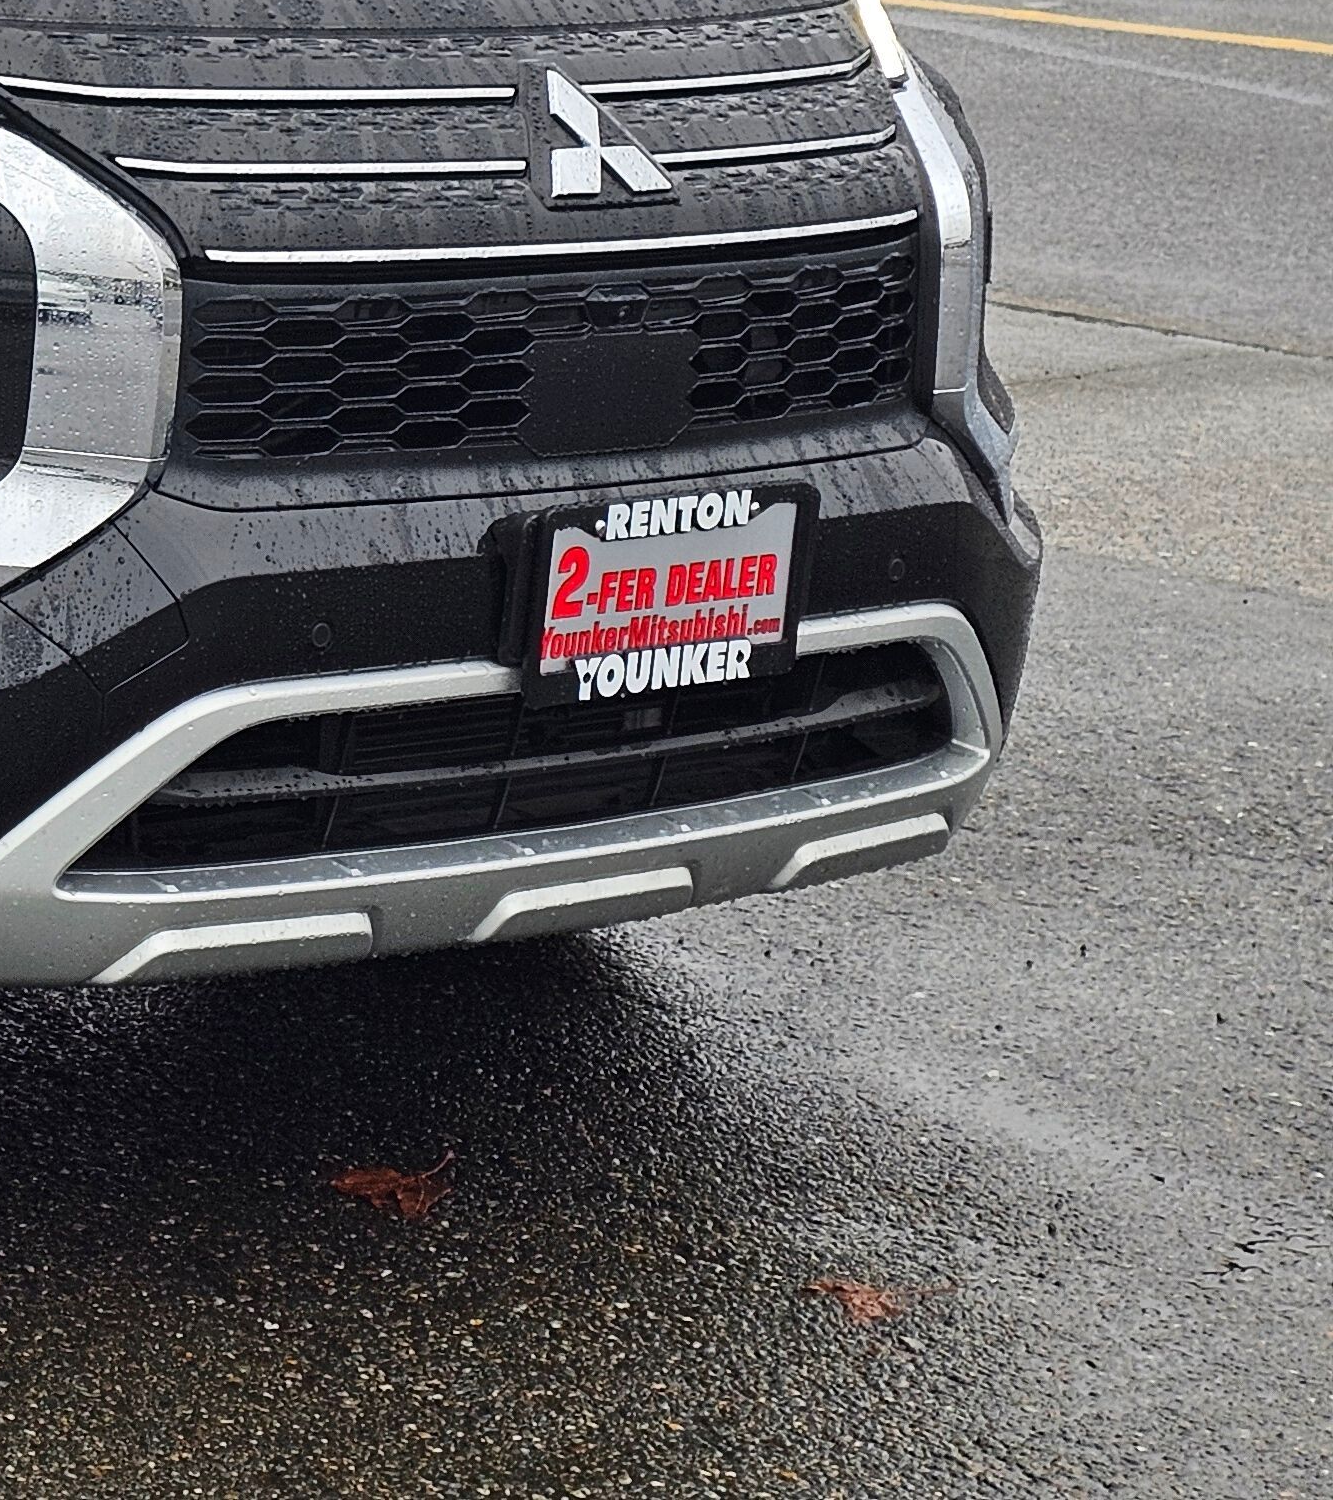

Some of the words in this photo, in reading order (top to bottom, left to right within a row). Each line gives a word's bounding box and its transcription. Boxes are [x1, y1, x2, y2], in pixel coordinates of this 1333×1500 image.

[605, 489, 753, 541] RENTON
[550, 545, 657, 621] 2-FER
[664, 552, 778, 608] DEALER
[539, 603, 781, 661] YounkerMitsubishi.com
[574, 638, 753, 701] YOUNKER
